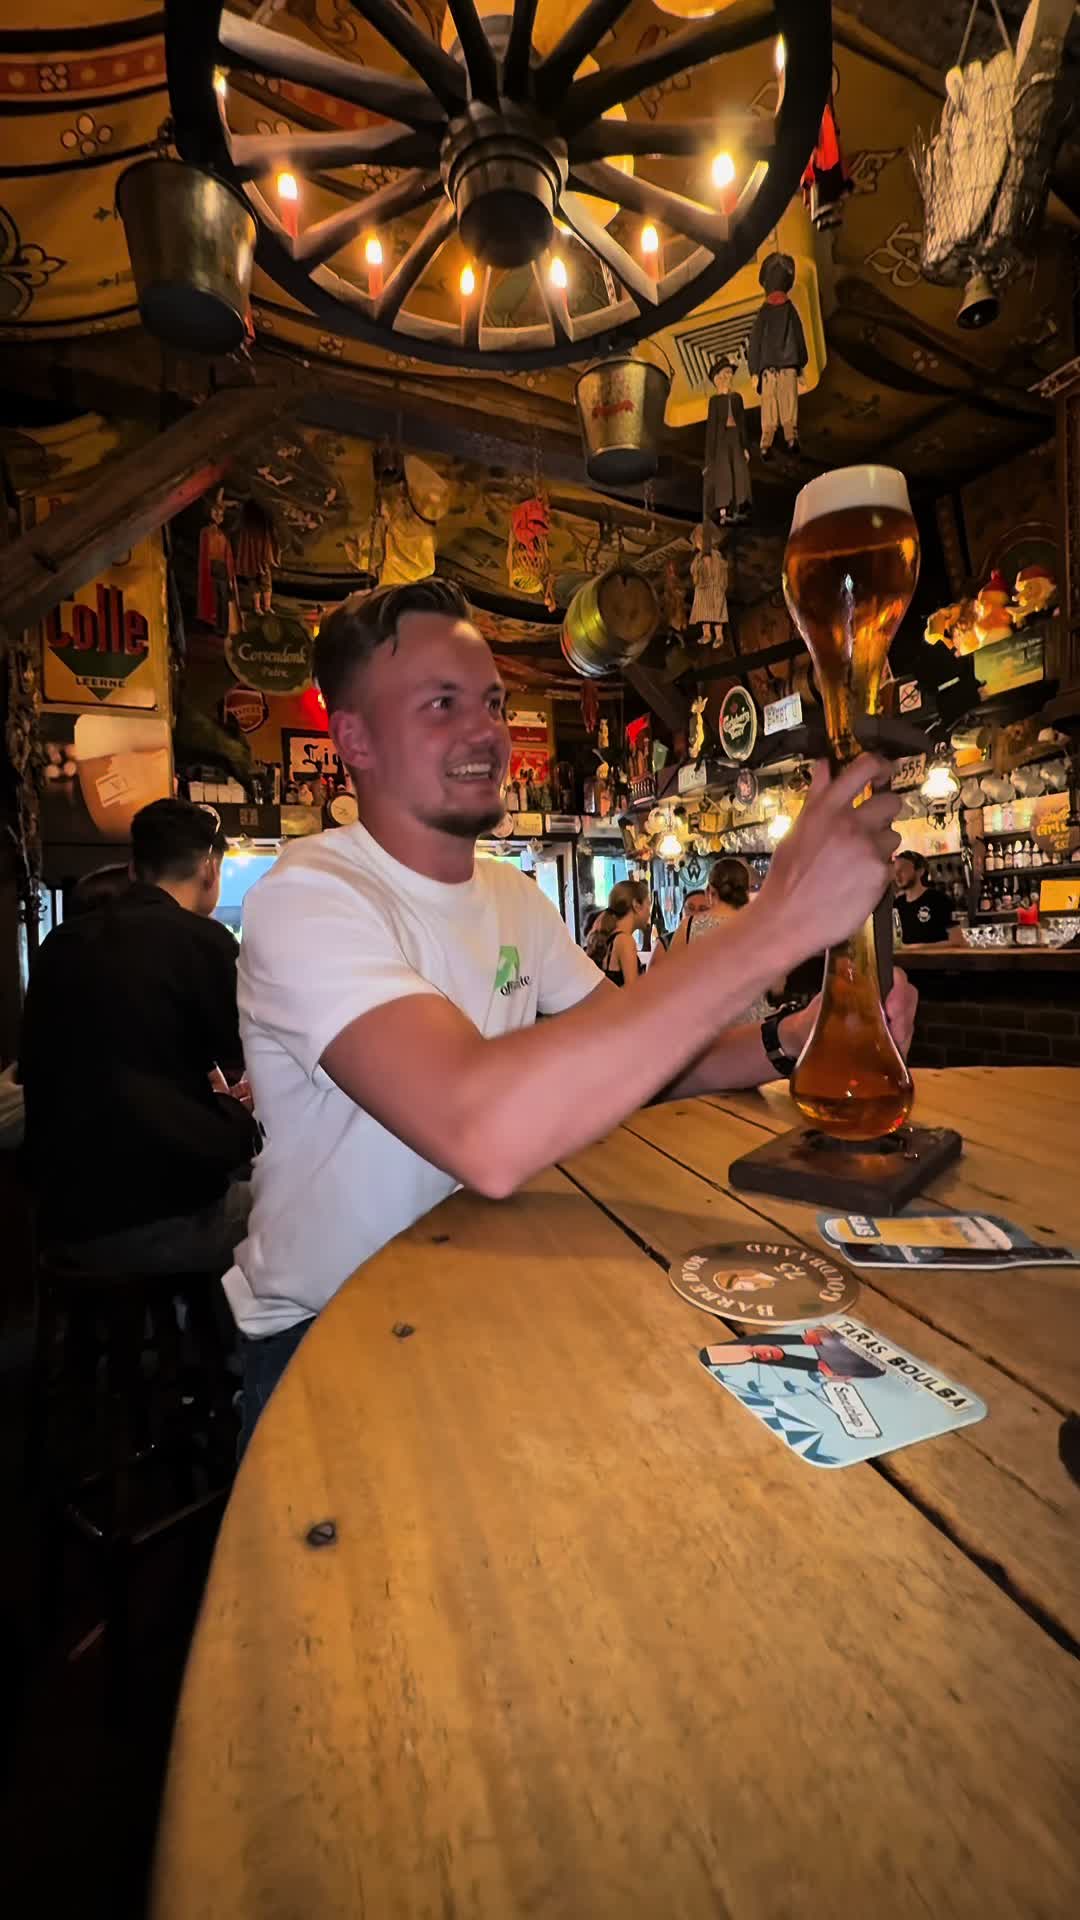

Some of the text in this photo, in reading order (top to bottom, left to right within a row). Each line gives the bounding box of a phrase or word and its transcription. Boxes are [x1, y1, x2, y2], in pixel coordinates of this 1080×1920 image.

[689, 1283, 776, 1317] BARBE
[837, 1321, 889, 1355] TARAS
[887, 1356, 968, 1408] BOULBA
